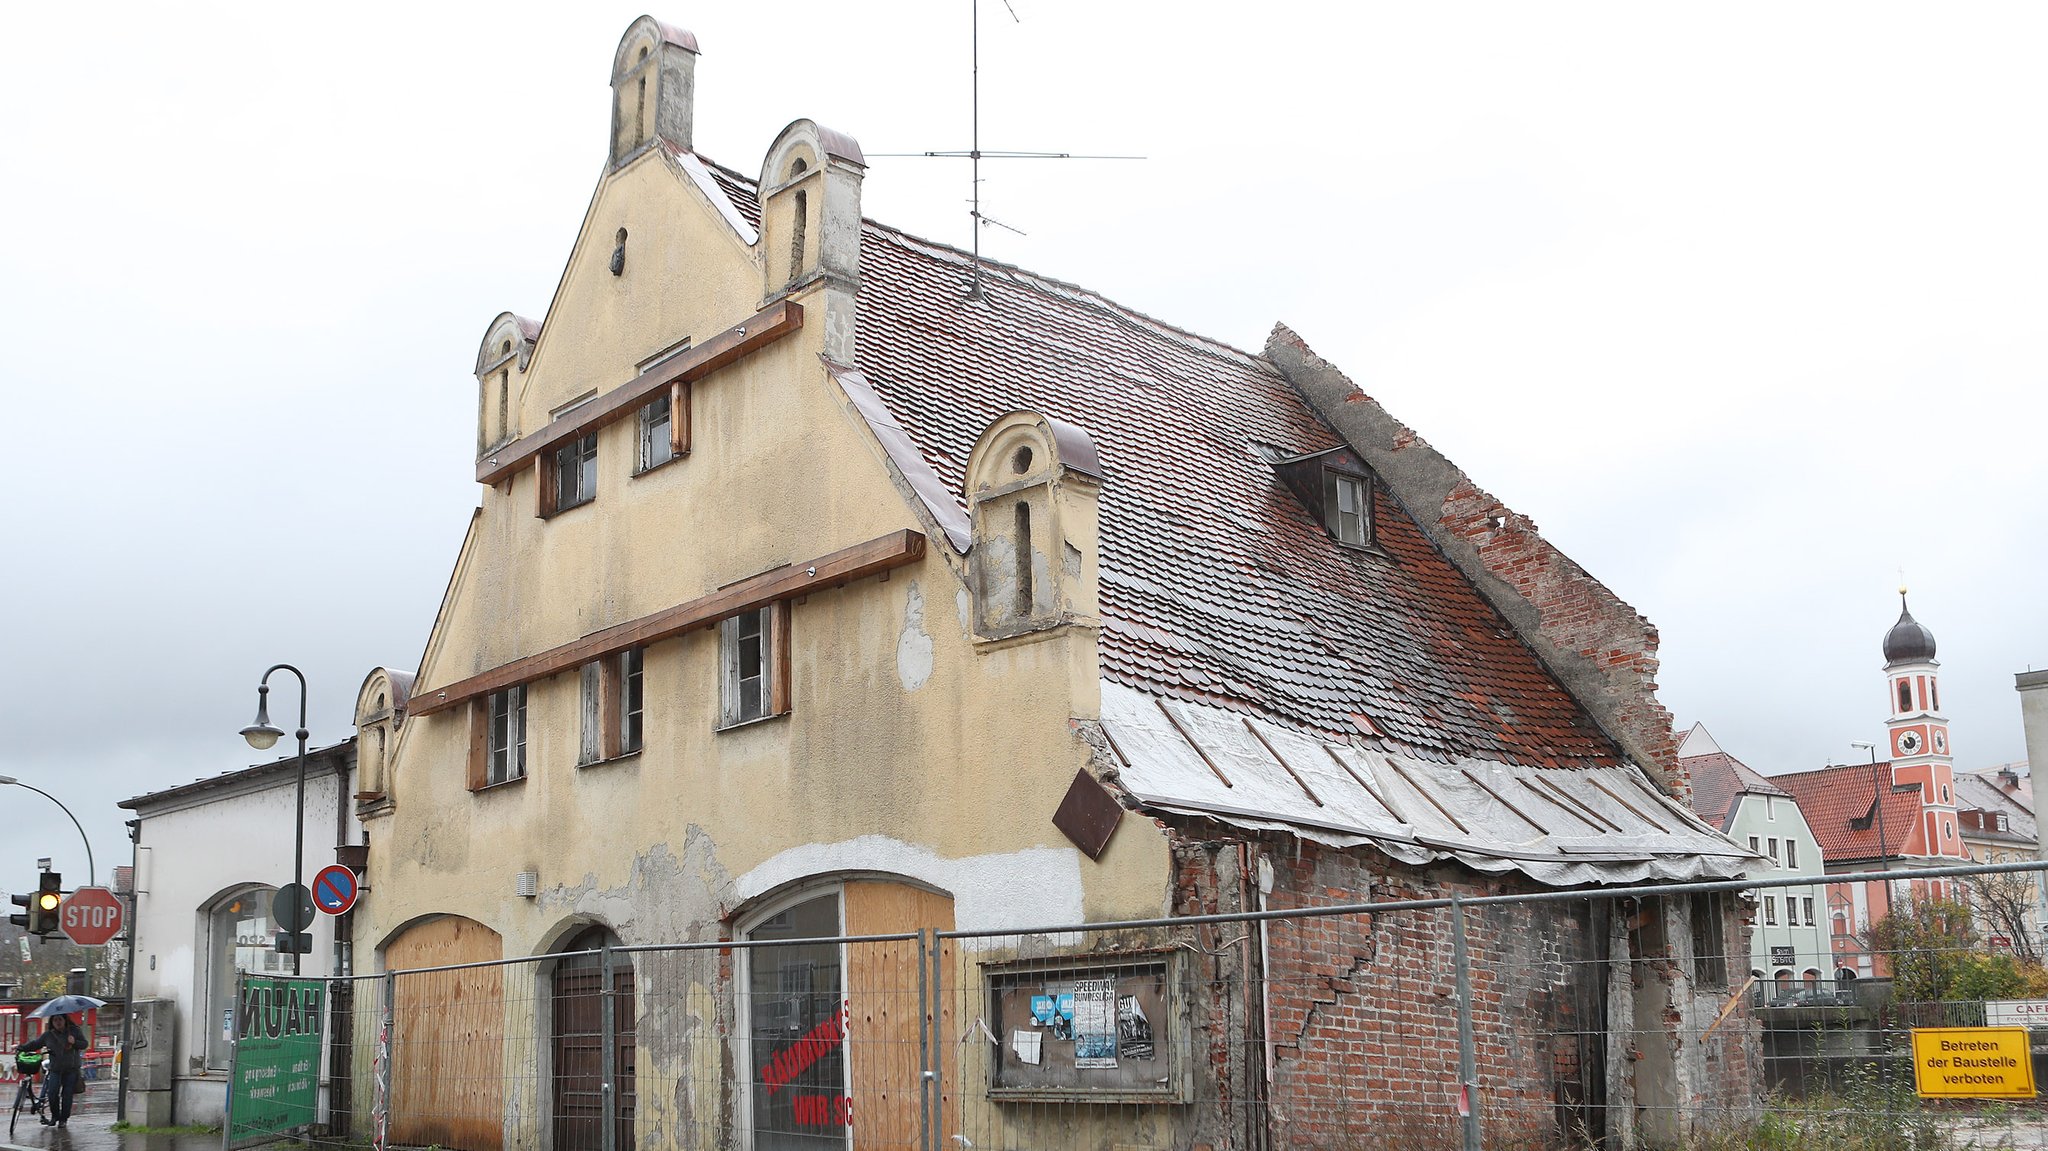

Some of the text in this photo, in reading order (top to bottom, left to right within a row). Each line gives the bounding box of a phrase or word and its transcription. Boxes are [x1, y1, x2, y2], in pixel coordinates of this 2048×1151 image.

[66, 905, 117, 928] STOP
[1075, 980, 1116, 992] SPEEDWAY
[1075, 992, 1114, 1001] BUNDESLIGA
[1941, 1040, 1998, 1051] Betreten
[1927, 1056, 2017, 1068] der Baustelle
[1943, 1073, 2003, 1084] verboten
[793, 1095, 828, 1126] WIR
